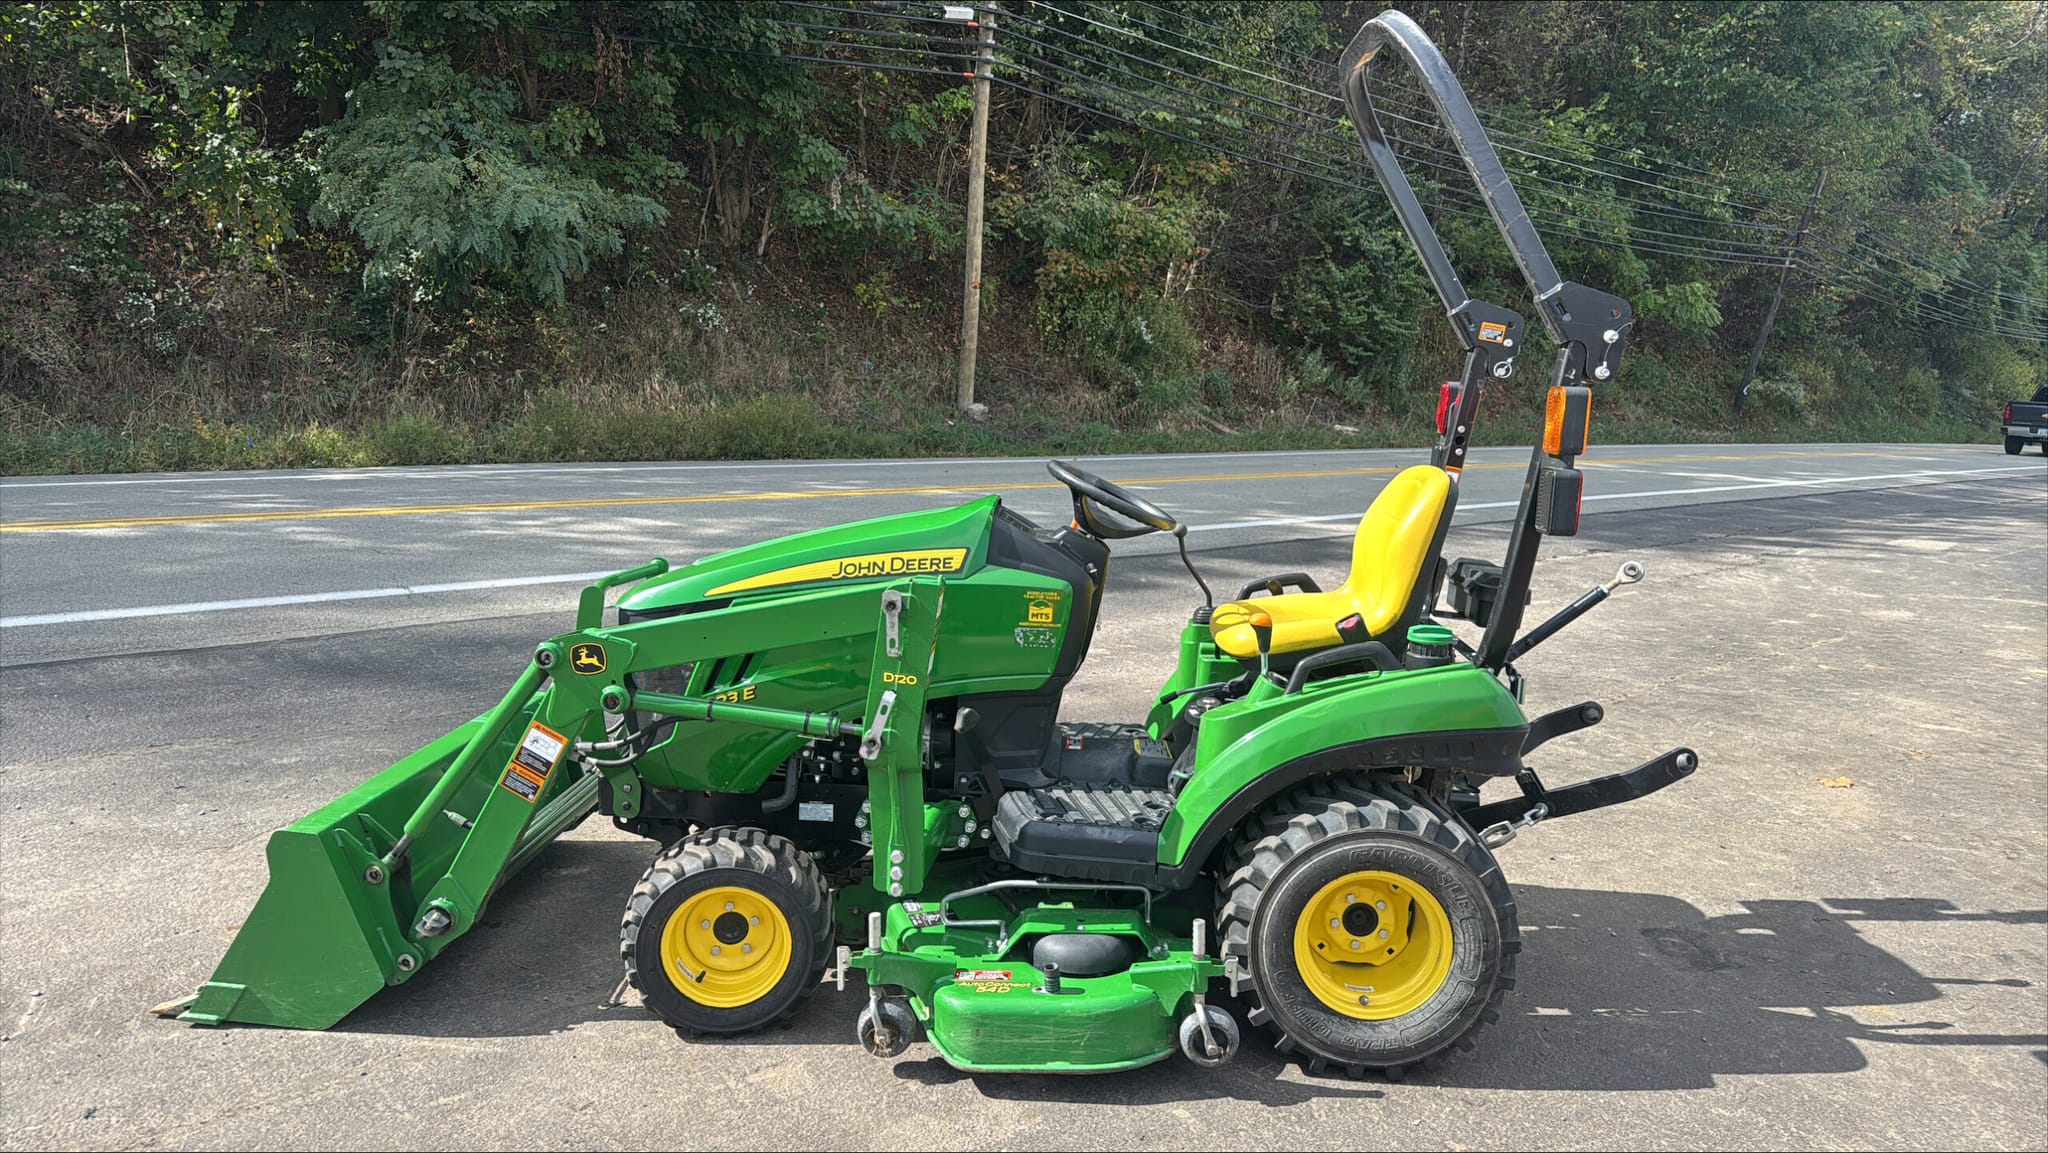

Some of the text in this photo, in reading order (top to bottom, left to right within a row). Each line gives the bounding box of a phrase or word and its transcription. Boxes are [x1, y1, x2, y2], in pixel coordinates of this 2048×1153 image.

[832, 557, 954, 578] JOHN DEERE
[1031, 612, 1051, 621] MTS
[883, 672, 917, 685] D120
[743, 685, 757, 701] E
